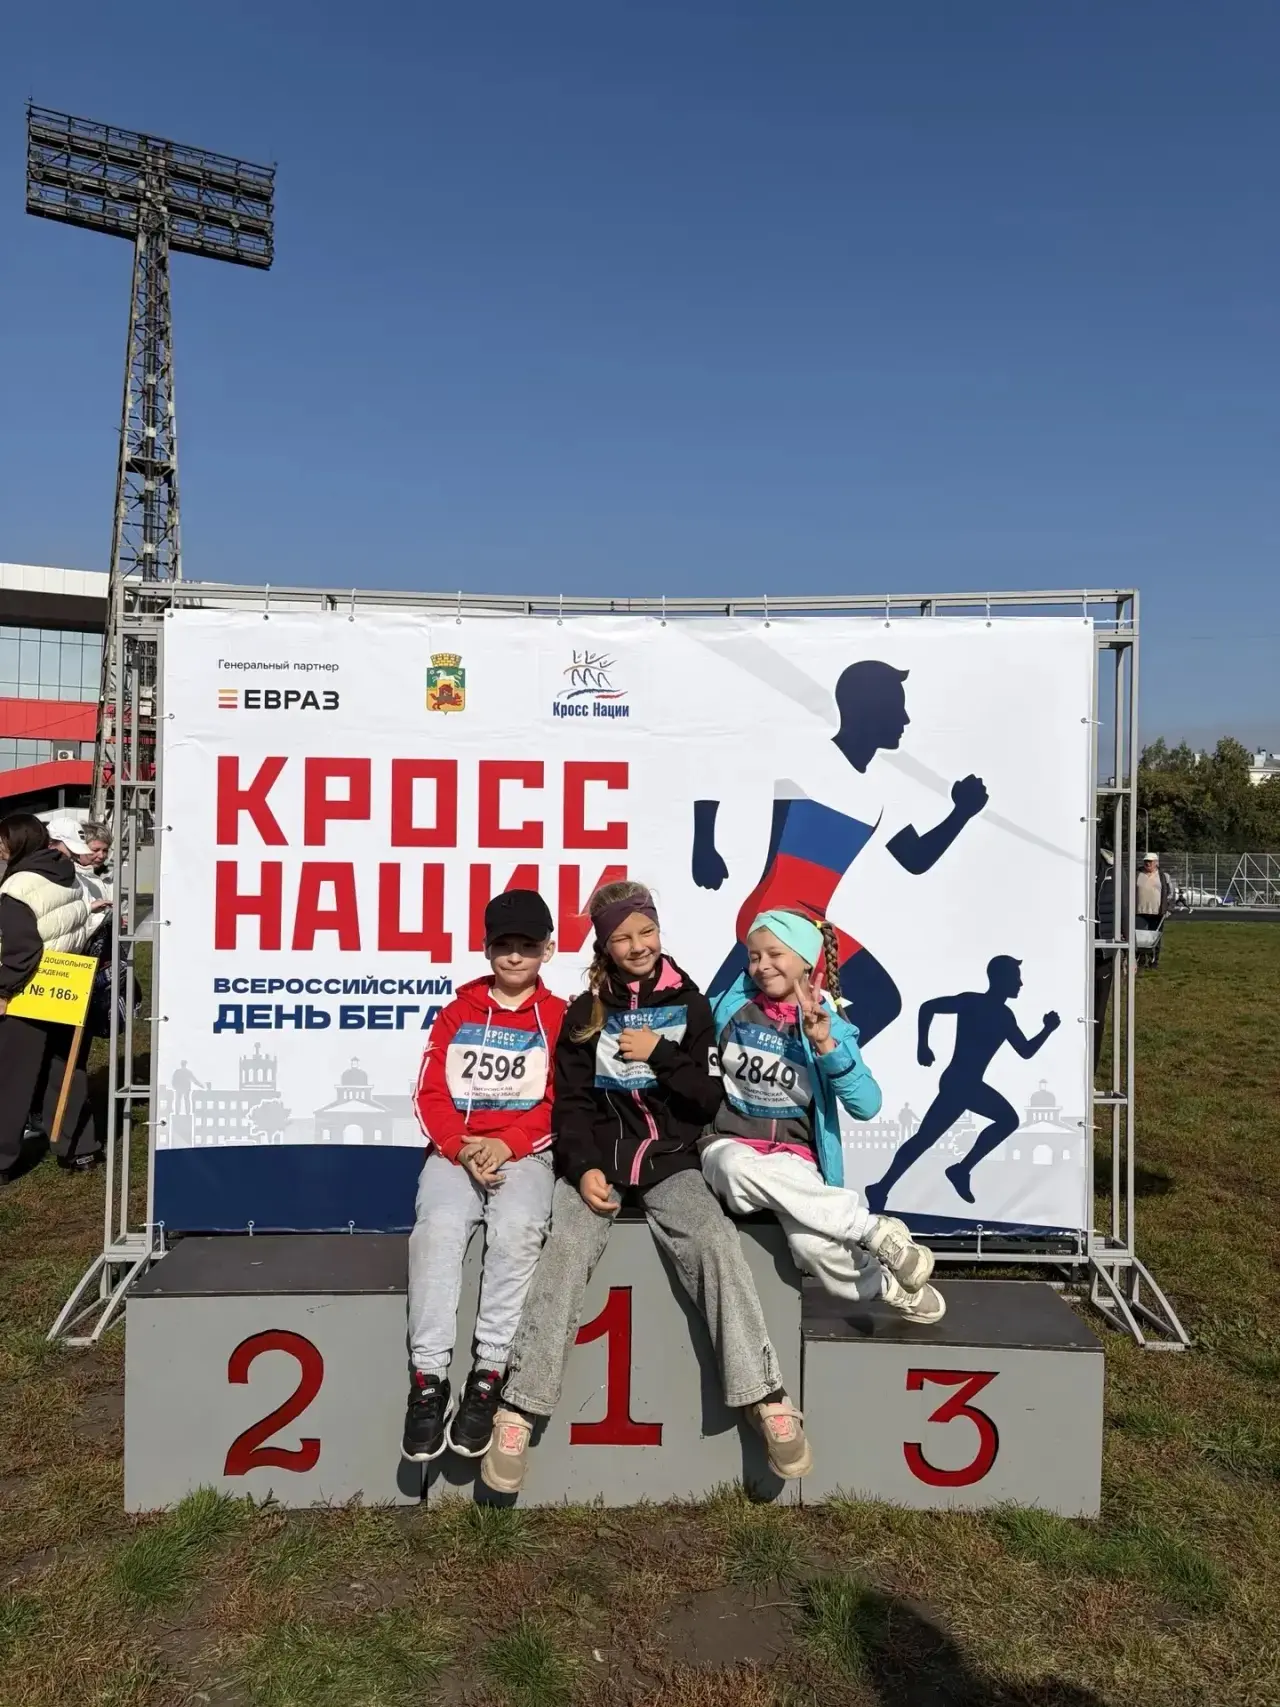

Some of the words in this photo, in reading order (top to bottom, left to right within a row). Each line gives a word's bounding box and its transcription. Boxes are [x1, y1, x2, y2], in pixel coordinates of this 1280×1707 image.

[218, 659, 290, 671] Генеральный
[293, 661, 340, 673] партнер
[244, 689, 340, 711] ЕВРАЗ
[553, 701, 589, 719] Кросс
[593, 702, 630, 719] Нации
[215, 755, 629, 850] КРОСС
[38, 967, 70, 978] ЕЖДЕНИЕ
[44, 956, 93, 969] ДОШКОЛЬНОЕ
[213, 975, 453, 996] ВСЕРОССИЙСКИЙ
[213, 1004, 332, 1035] ДЕНЬ
[461, 1050, 526, 1082] 2598
[737, 1052, 795, 1089] 2849
[571, 1286, 662, 1447] 1
[224, 1329, 324, 1477] 2
[903, 1369, 1000, 1488] 3
